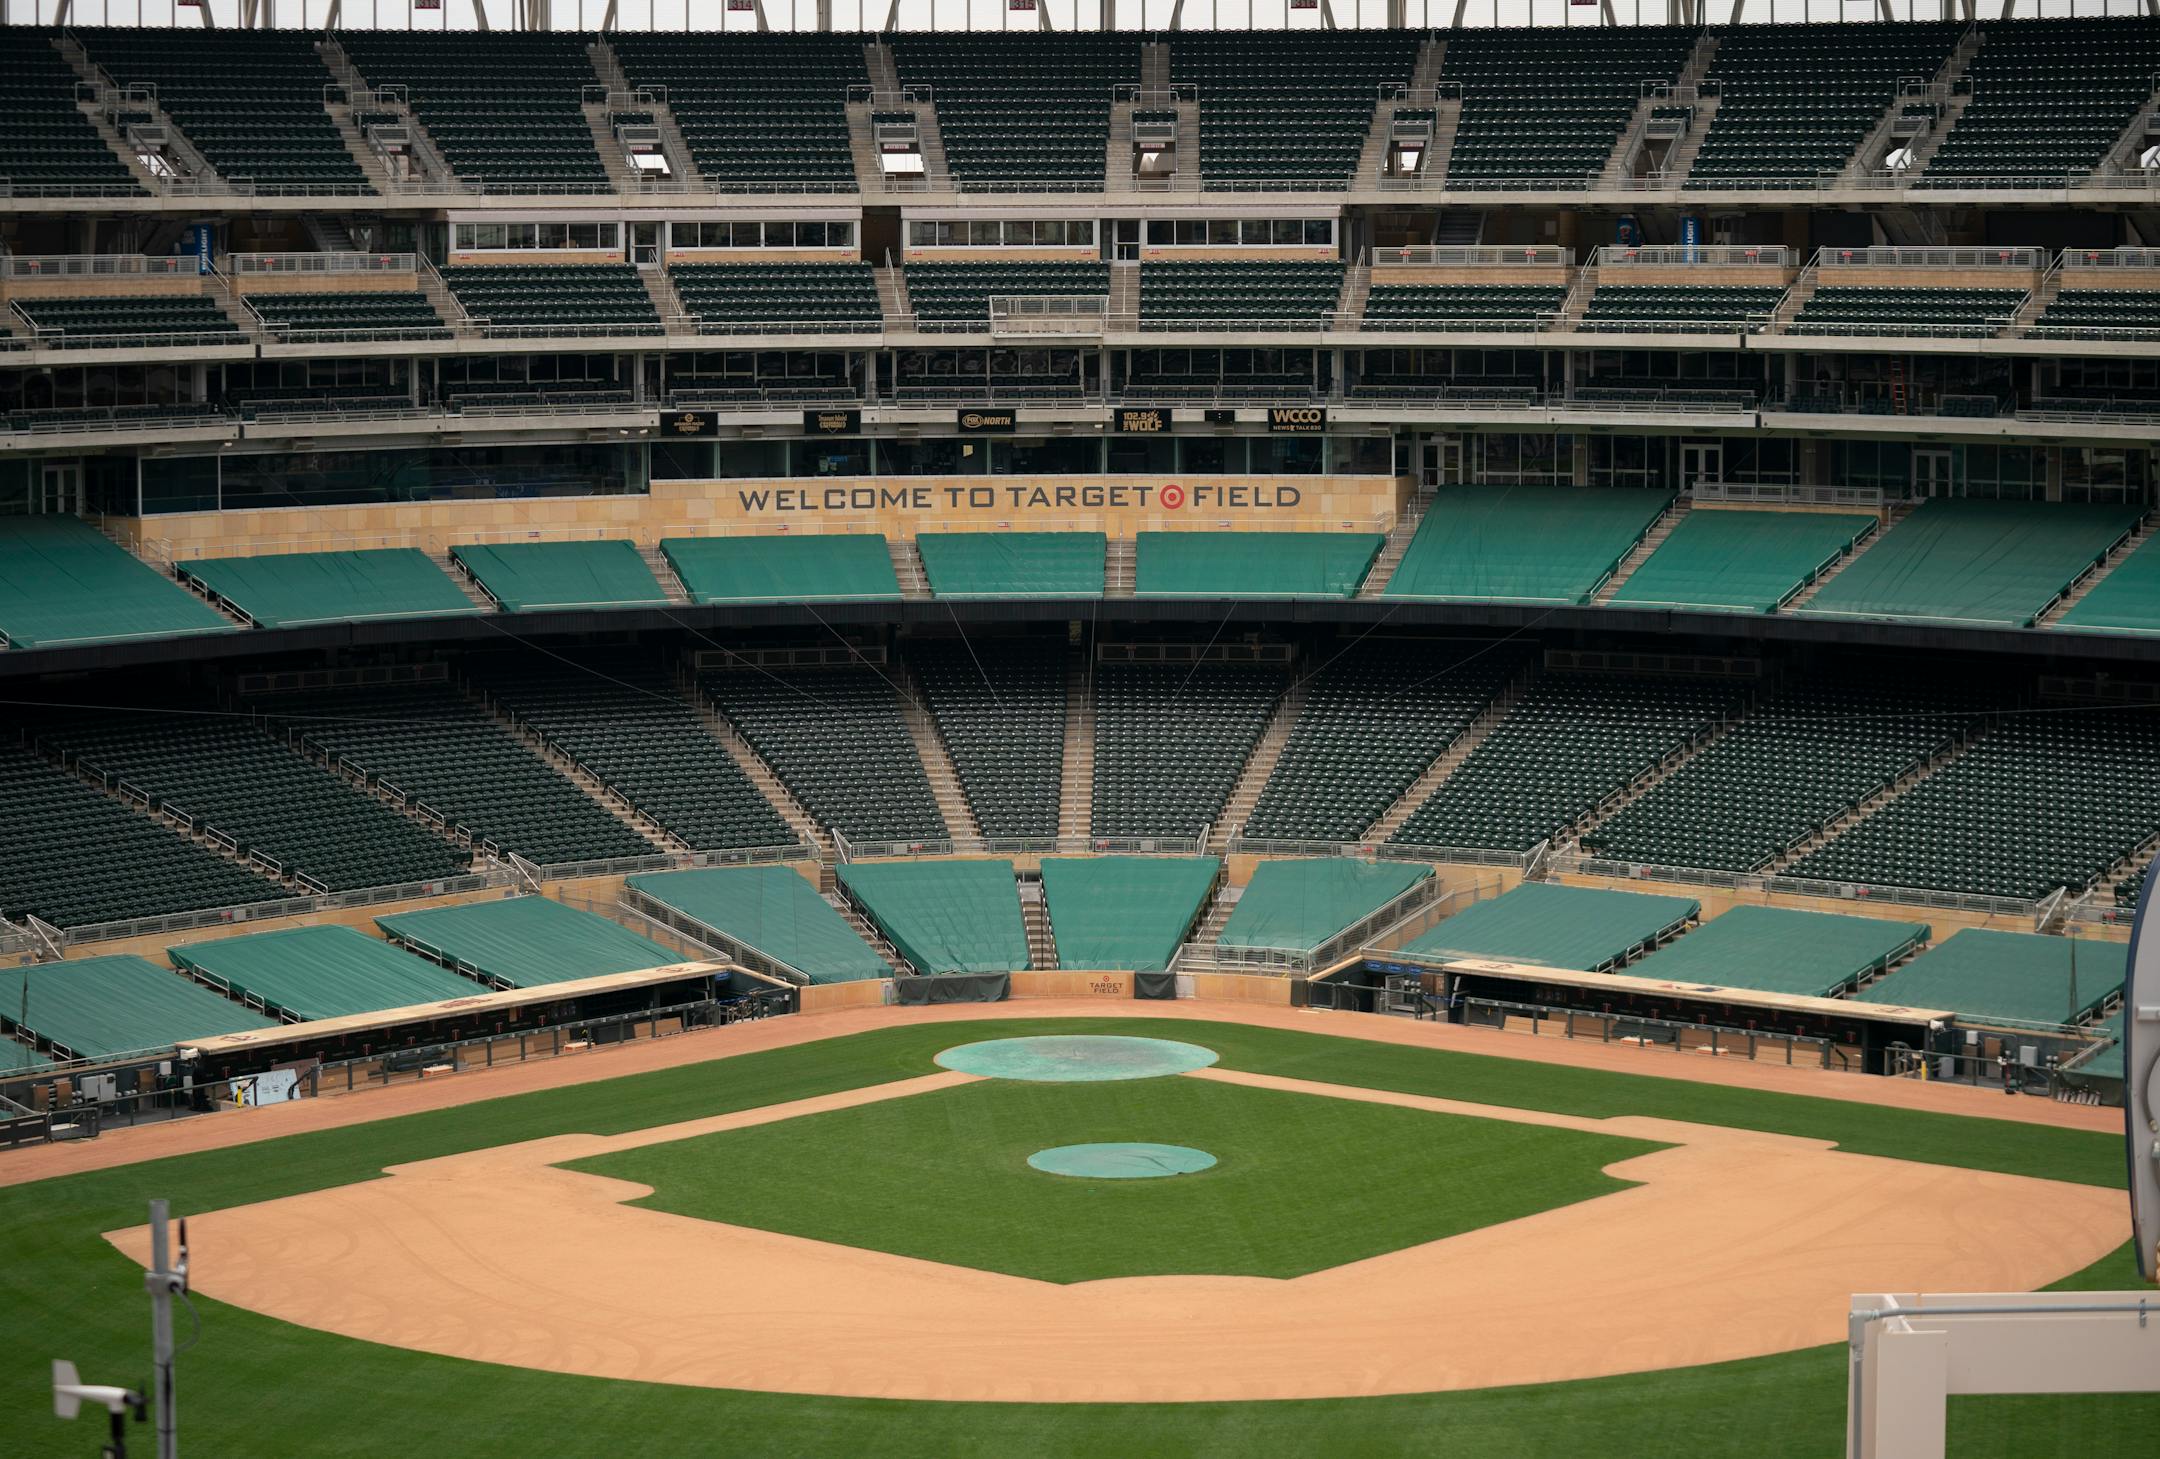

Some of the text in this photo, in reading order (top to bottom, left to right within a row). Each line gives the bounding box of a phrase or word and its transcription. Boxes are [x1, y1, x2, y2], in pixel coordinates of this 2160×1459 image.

[732, 0, 752, 9] 314
[1014, 0, 1034, 8] 315
[983, 416, 1011, 425] NORTH
[1123, 412, 1147, 420] 102.9
[1273, 409, 1321, 423] WCCO
[1129, 420, 1163, 431] WOLF
[739, 486, 1301, 511] WELCOME TO TARGET FIELD
